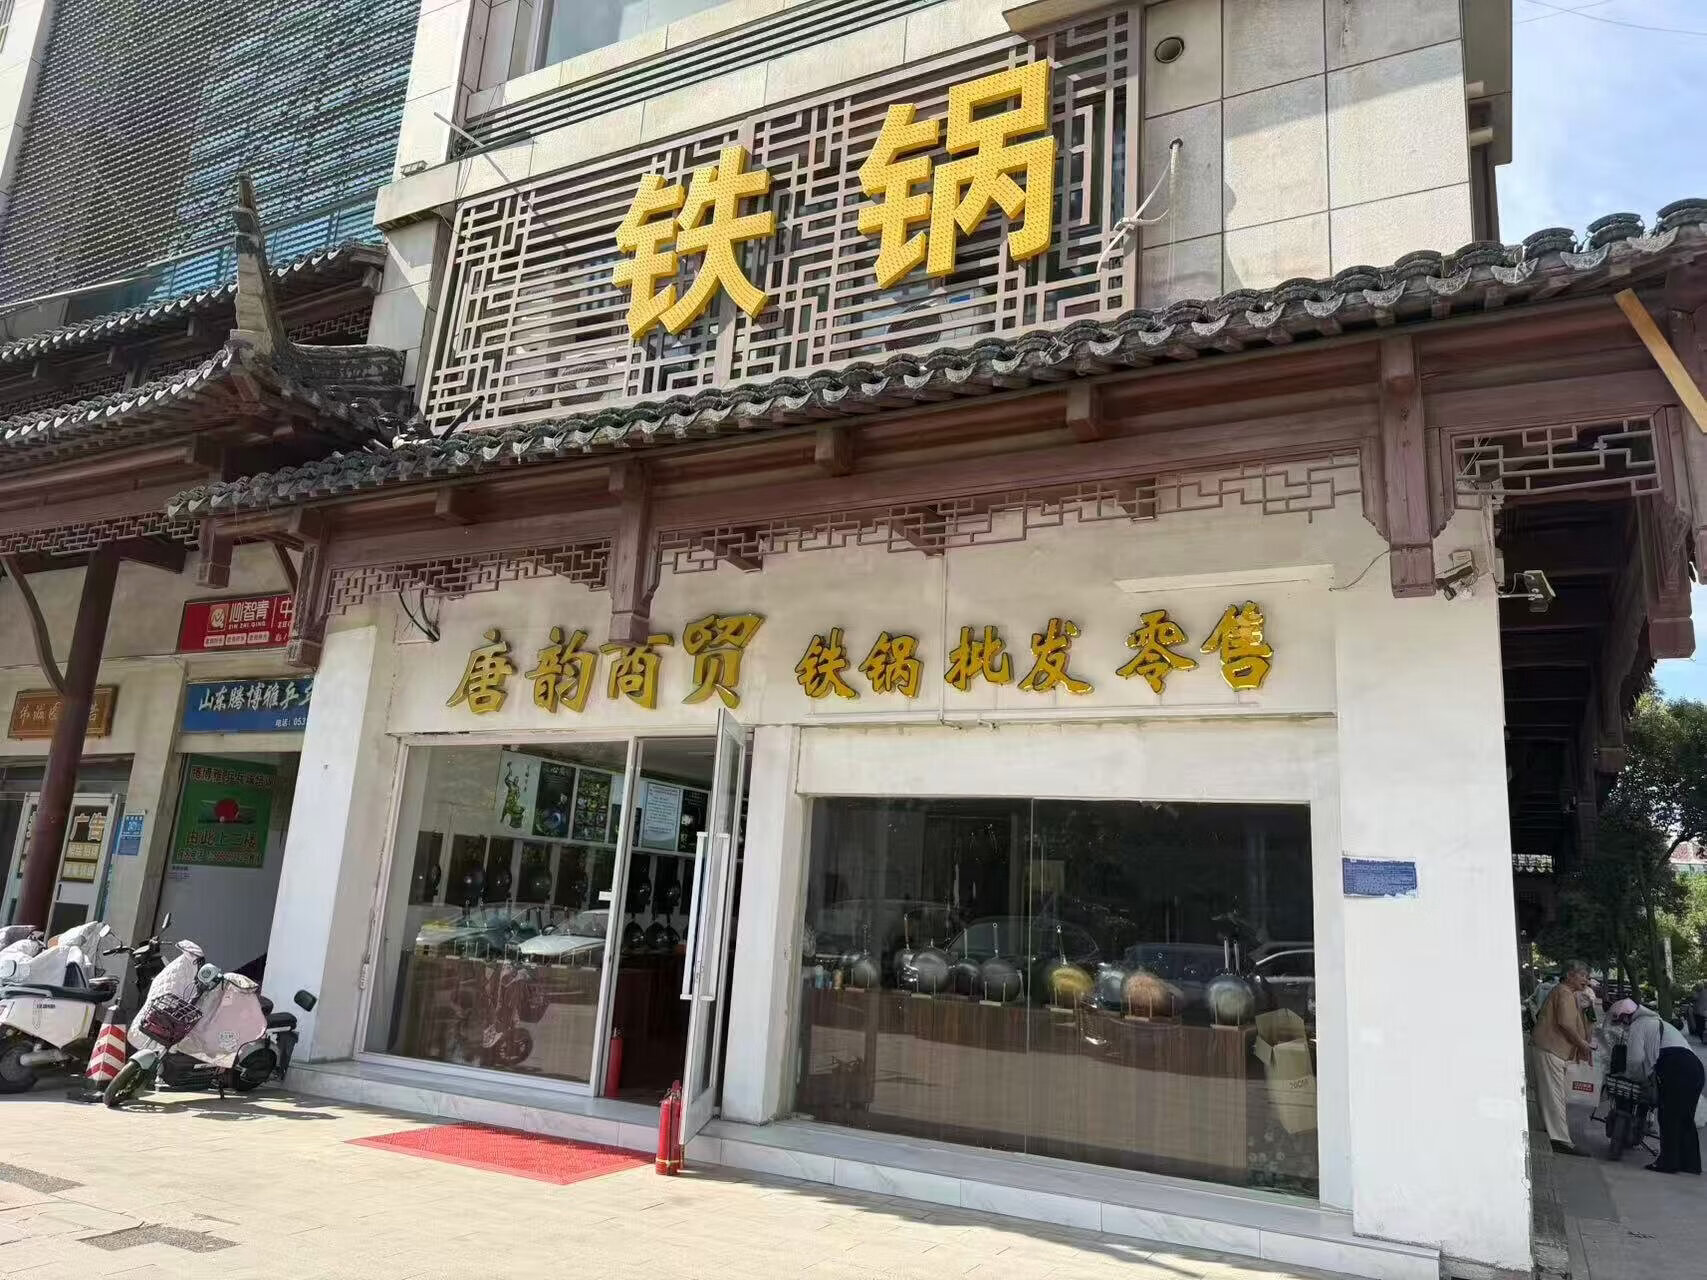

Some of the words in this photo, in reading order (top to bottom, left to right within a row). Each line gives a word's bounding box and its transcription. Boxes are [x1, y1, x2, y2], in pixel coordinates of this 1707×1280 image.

[611, 58, 1057, 339] 铁锅
[446, 613, 766, 713] 唐韵商贸
[797, 600, 1273, 700] 铁锅批发零售
